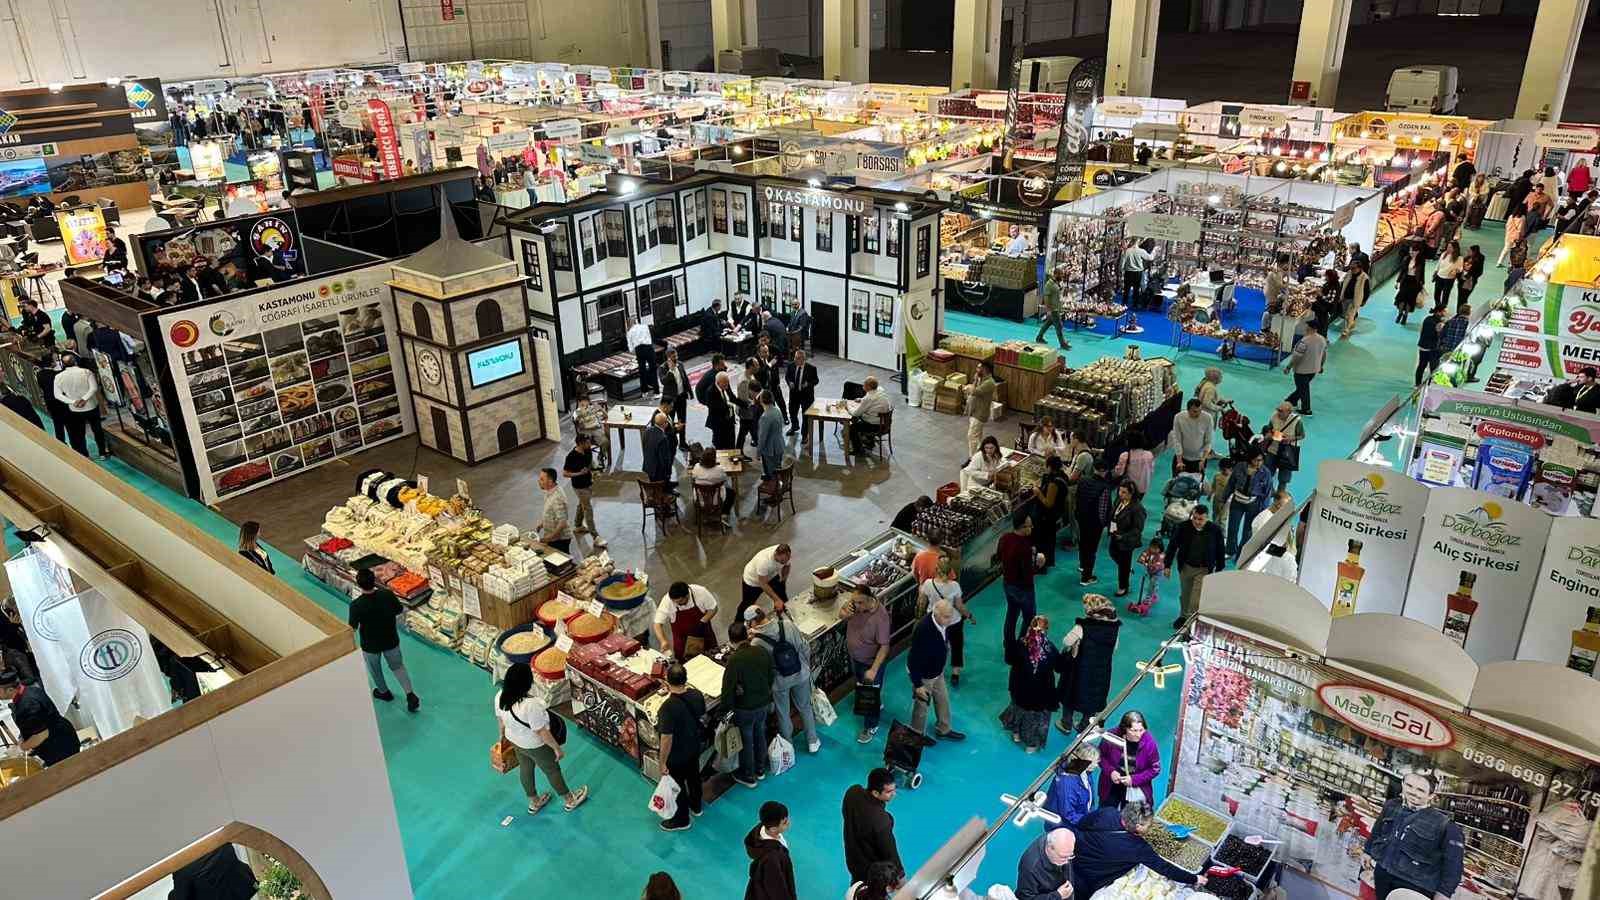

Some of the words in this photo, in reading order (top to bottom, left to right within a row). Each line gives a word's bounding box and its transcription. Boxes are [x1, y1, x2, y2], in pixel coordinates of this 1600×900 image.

[775, 188, 865, 213] KASTAMONU
[258, 291, 316, 313] KASTAMONU
[1320, 508, 1353, 530] Elma
[1354, 521, 1408, 542] Sirkesi
[1433, 540, 1461, 561] Alıç
[1462, 551, 1520, 573] Sirkesi
[1462, 747, 1506, 772] 0536
[1511, 764, 1545, 787] 699
[1549, 779, 1574, 797] 27
[1580, 789, 1600, 808] 75
